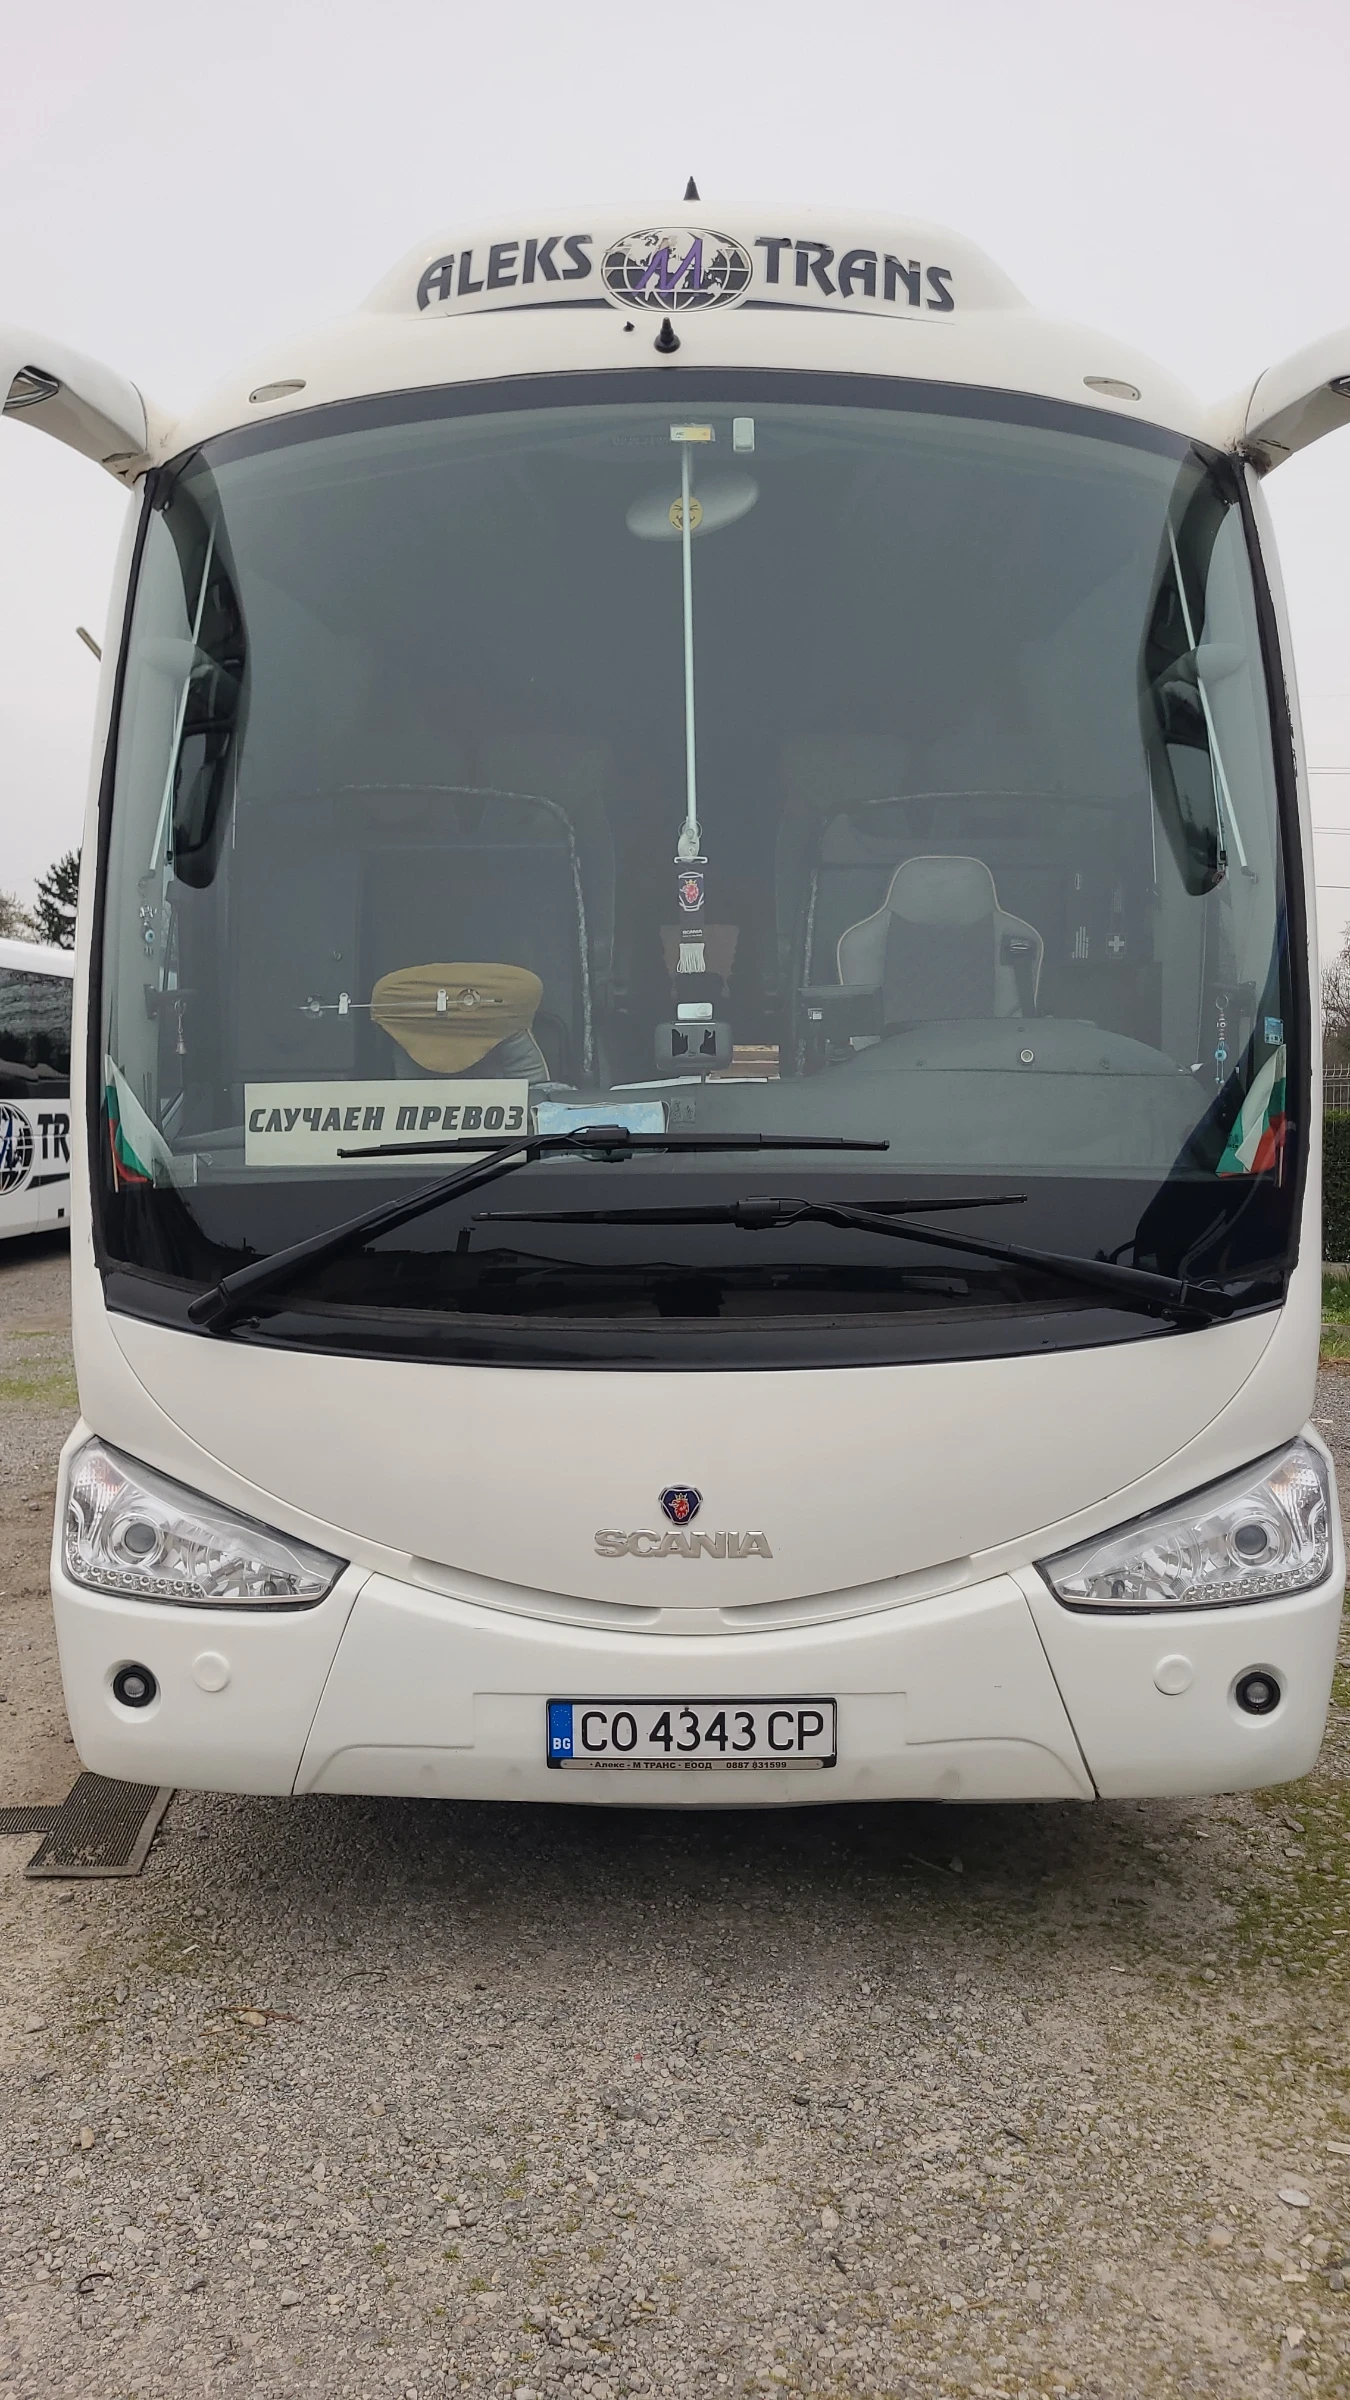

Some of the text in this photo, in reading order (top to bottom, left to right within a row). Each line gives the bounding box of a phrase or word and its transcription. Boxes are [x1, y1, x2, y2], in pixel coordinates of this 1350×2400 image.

[416, 234, 593, 312] ALEKS
[753, 236, 955, 313] TRANS
[248, 1105, 524, 1133] СЛУЧАЕН ПРЕВОЗ
[594, 1528, 774, 1559] SCANIA
[552, 1737, 571, 1750] BG
[648, 1711, 756, 1752] 4343
[725, 1761, 750, 1769] 0887
[751, 1761, 788, 1769] 831599
